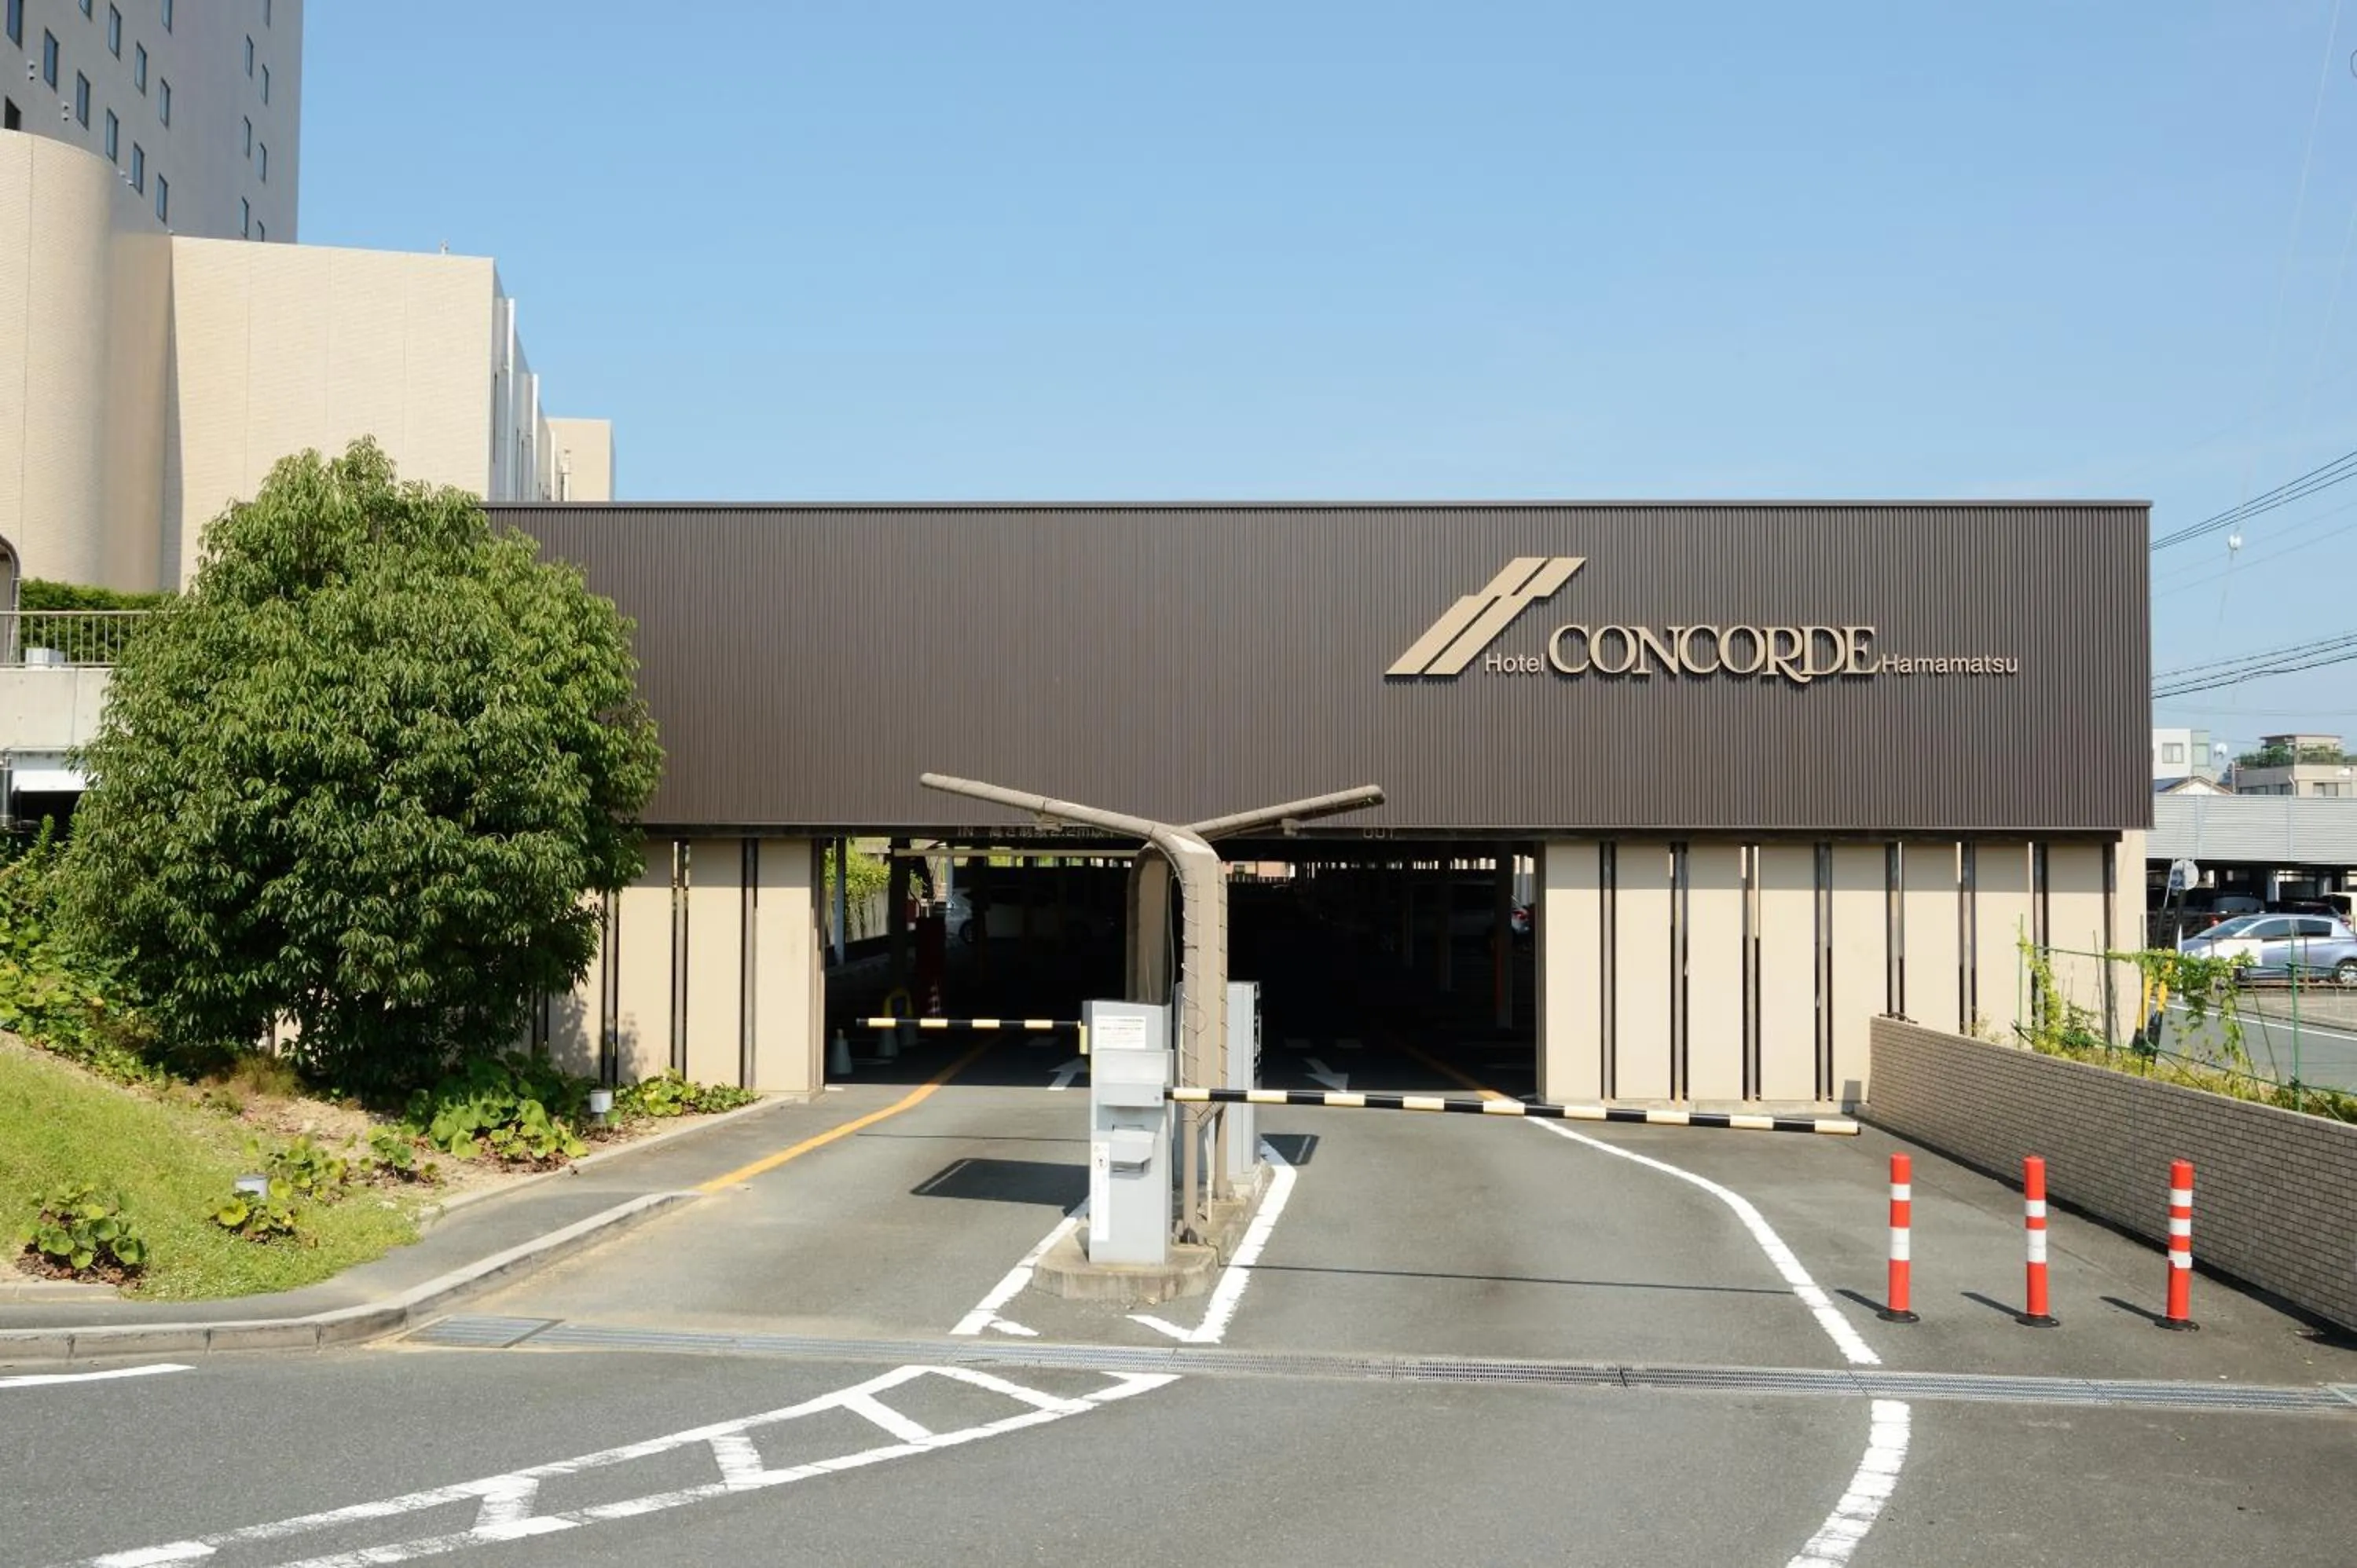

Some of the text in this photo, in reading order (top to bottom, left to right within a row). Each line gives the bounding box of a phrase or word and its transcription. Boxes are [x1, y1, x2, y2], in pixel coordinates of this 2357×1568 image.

[1485, 625, 2018, 683] Hotel CONCORDE Hamamatsu
